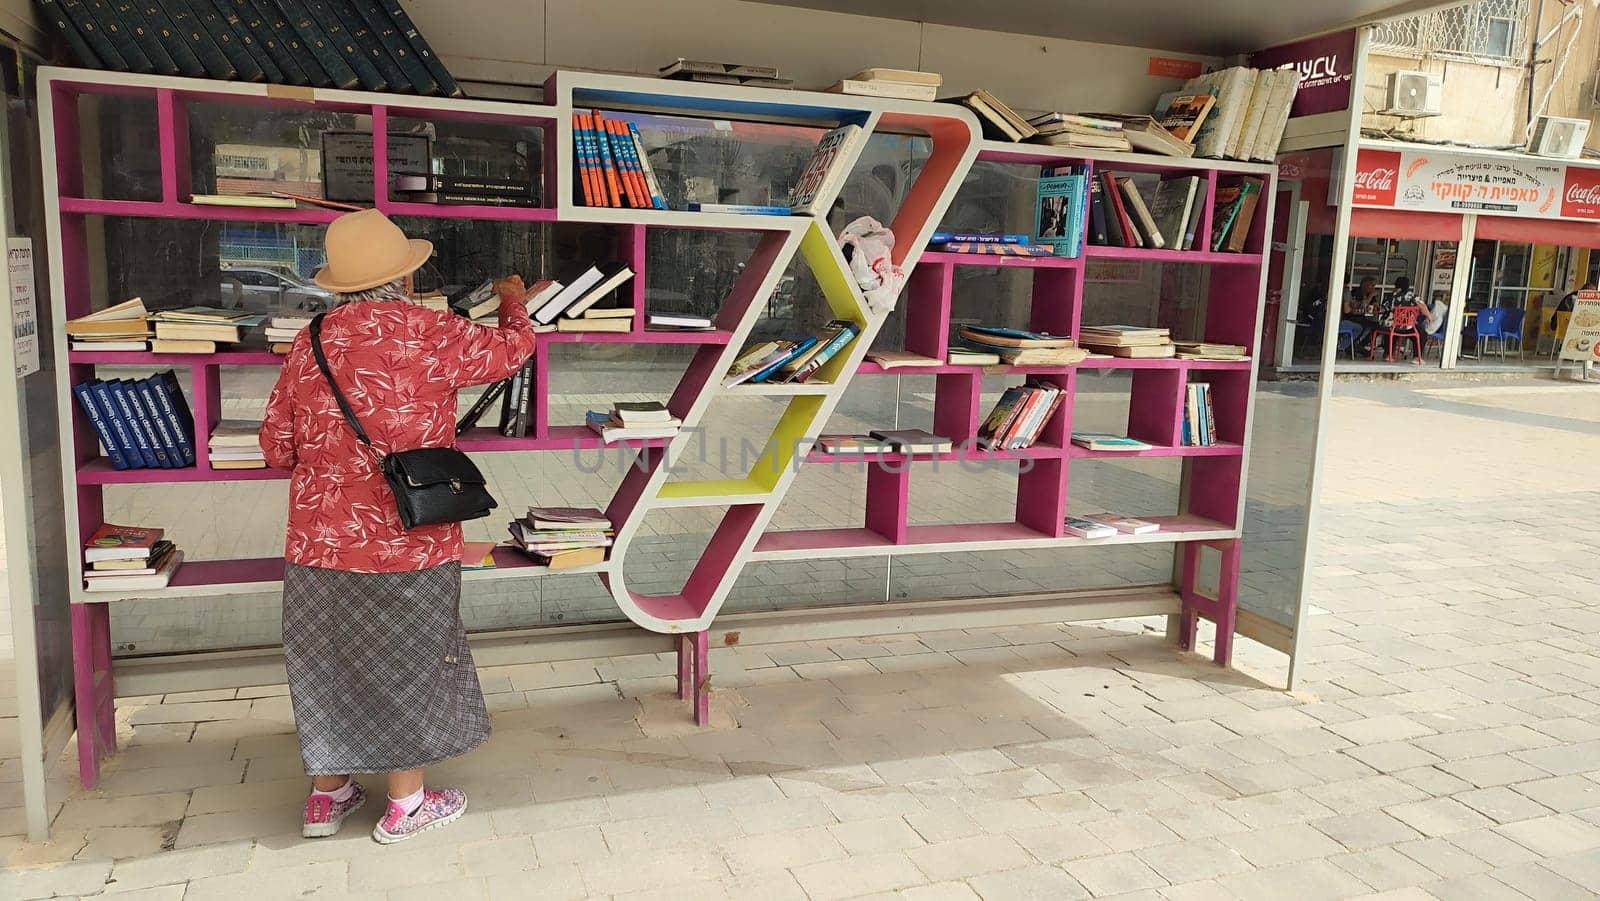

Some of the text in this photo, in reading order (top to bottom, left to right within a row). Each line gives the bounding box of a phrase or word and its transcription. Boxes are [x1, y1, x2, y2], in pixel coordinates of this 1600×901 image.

[1457, 173, 1483, 183] פיצרייה
[1484, 174, 1491, 183] &
[1492, 175, 1517, 185] מאפייה
[1490, 186, 1541, 203] מאפיית
[157, 451, 166, 461] 6
[182, 447, 193, 457] 2
[112, 453, 121, 463] 3
